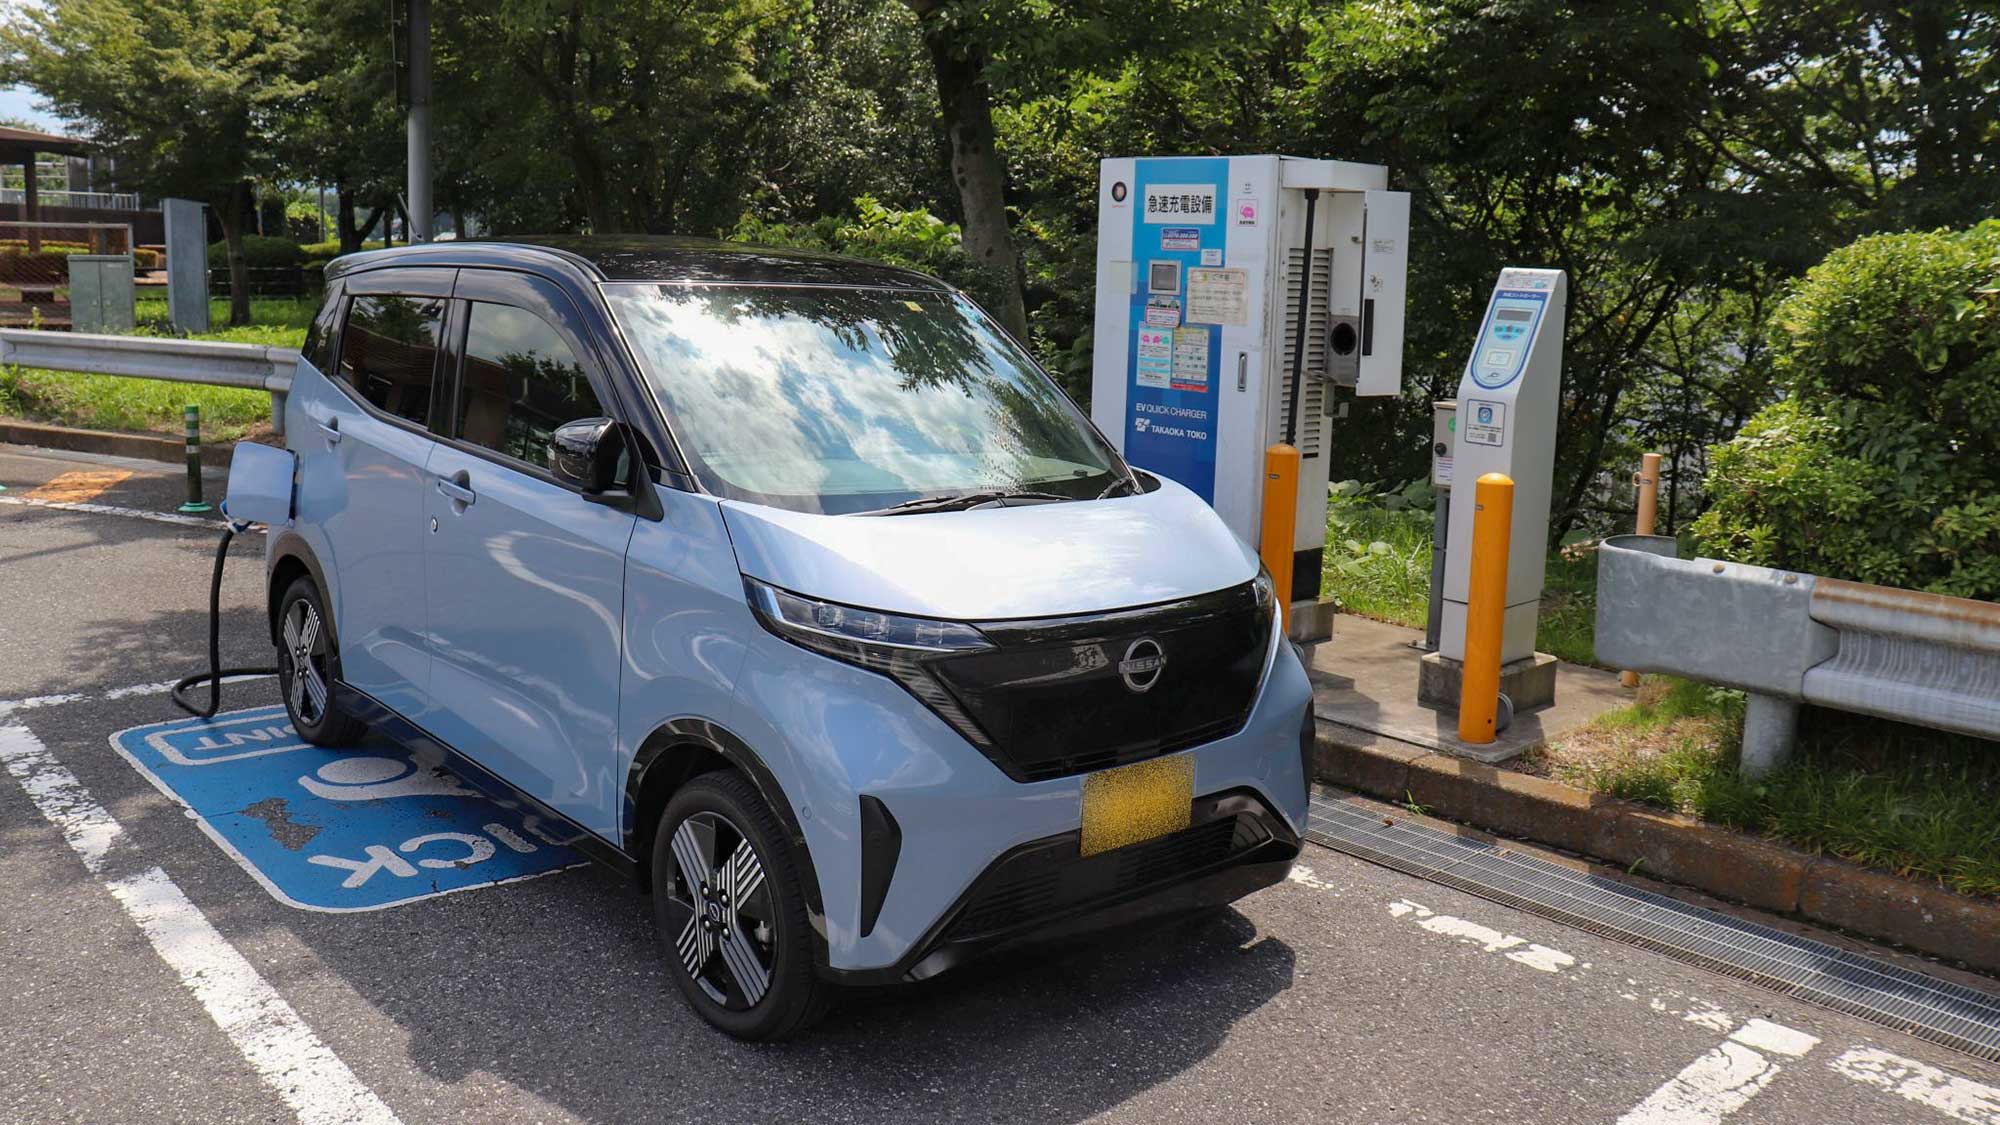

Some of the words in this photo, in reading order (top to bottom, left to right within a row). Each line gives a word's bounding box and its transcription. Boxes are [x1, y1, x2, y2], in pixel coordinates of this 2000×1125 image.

[1147, 195, 1213, 214] 急速充電設備
[1136, 402, 1147, 412] EV
[1146, 404, 1170, 415] QUICK
[1170, 406, 1207, 419] CHARGER
[1151, 425, 1185, 437] TAKAOKA
[1186, 429, 1207, 440] TOKO
[1121, 655, 1166, 672] NISSAN
[194, 725, 297, 750] INT
[307, 823, 539, 888] ICK
